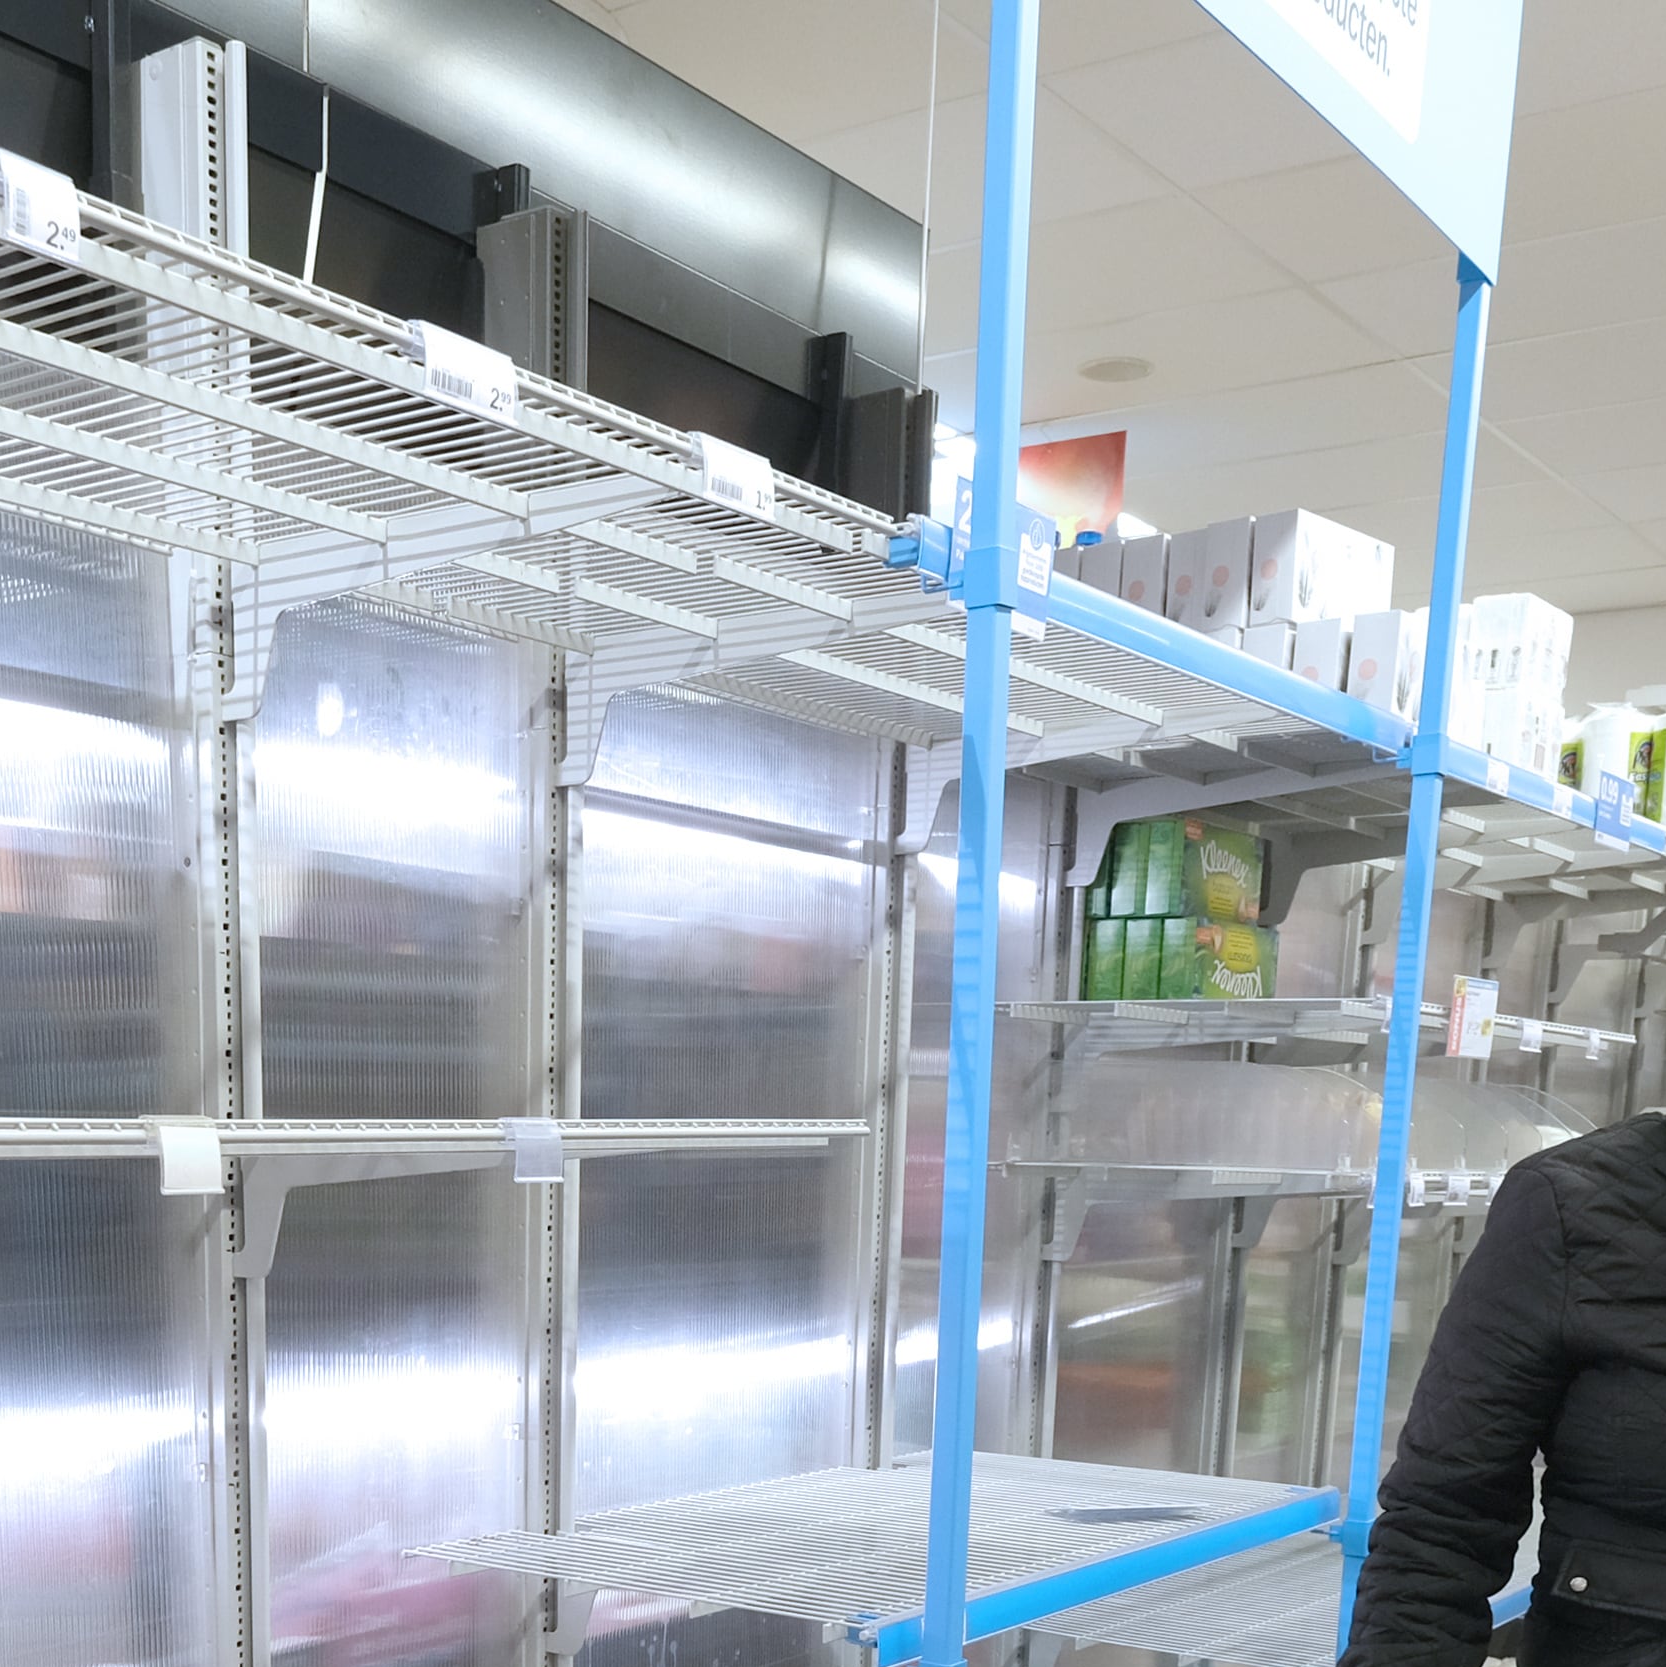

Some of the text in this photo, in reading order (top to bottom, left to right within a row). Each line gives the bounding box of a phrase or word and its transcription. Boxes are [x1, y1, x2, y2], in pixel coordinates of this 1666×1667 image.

[46, 221, 77, 250] 2.49
[490, 386, 512, 412] 2.99
[1199, 839, 1250, 888] Kleenex
